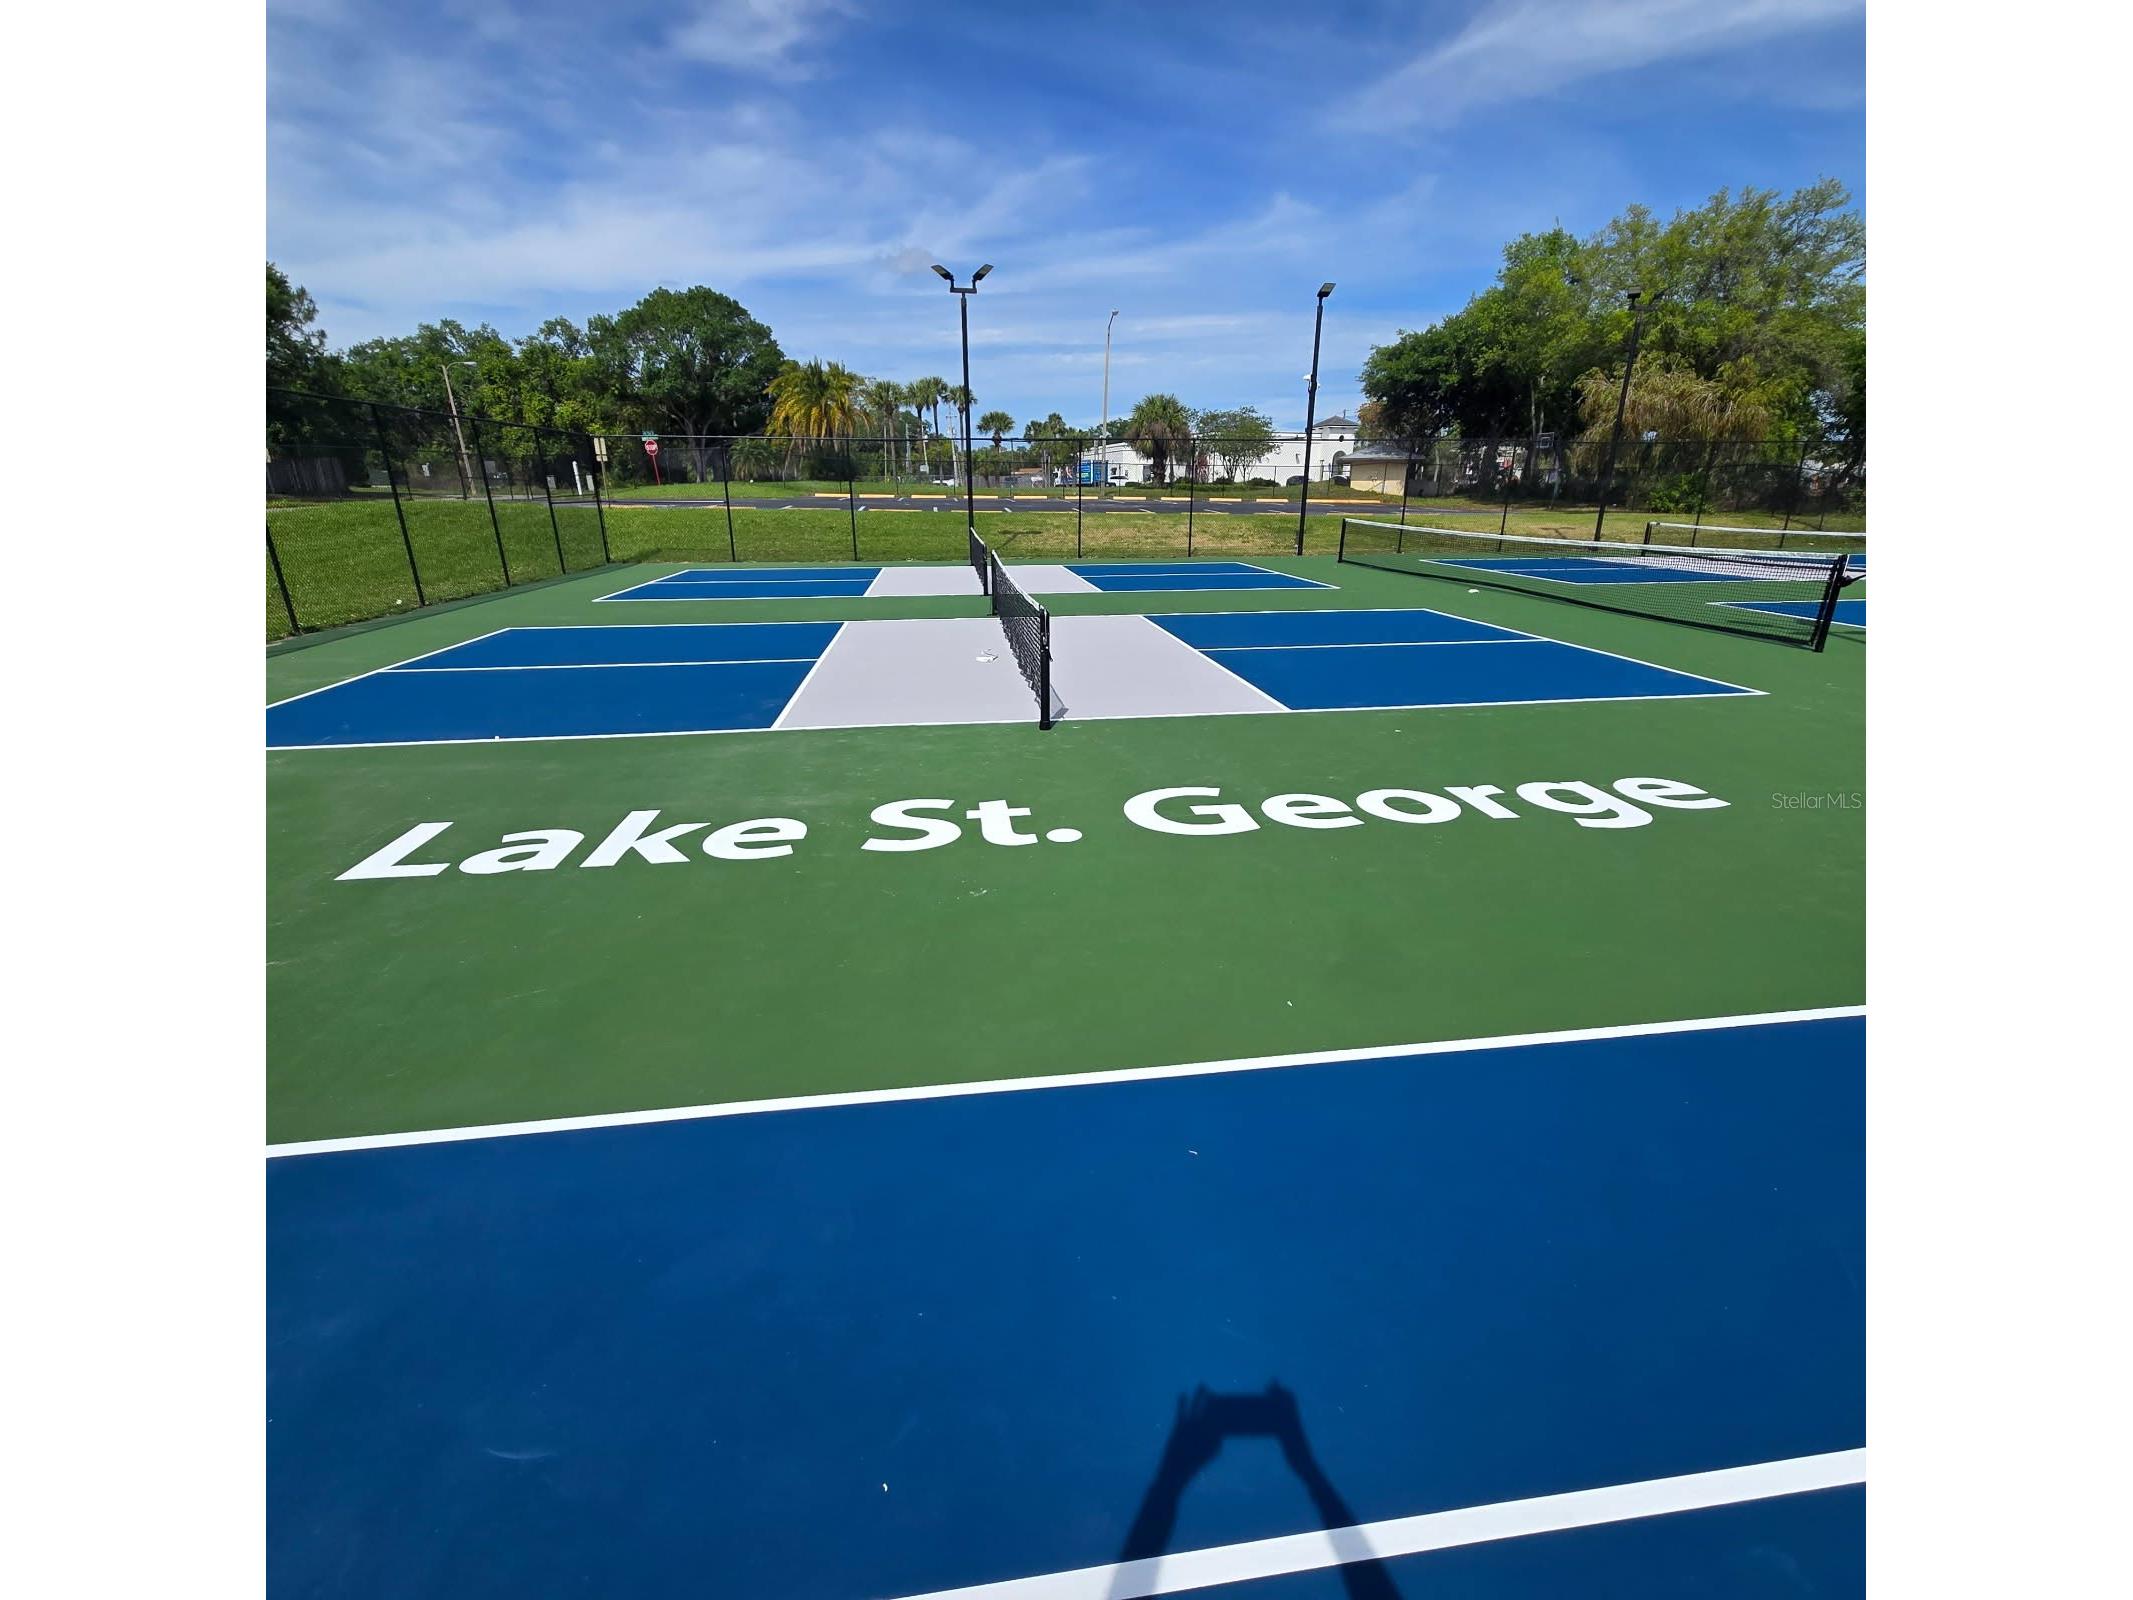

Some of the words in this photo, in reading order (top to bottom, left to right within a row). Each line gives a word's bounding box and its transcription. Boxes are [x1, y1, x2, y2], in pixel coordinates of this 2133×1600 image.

[334, 810, 808, 881] Lake
[861, 799, 1083, 852] St.
[1124, 778, 1731, 836] George
